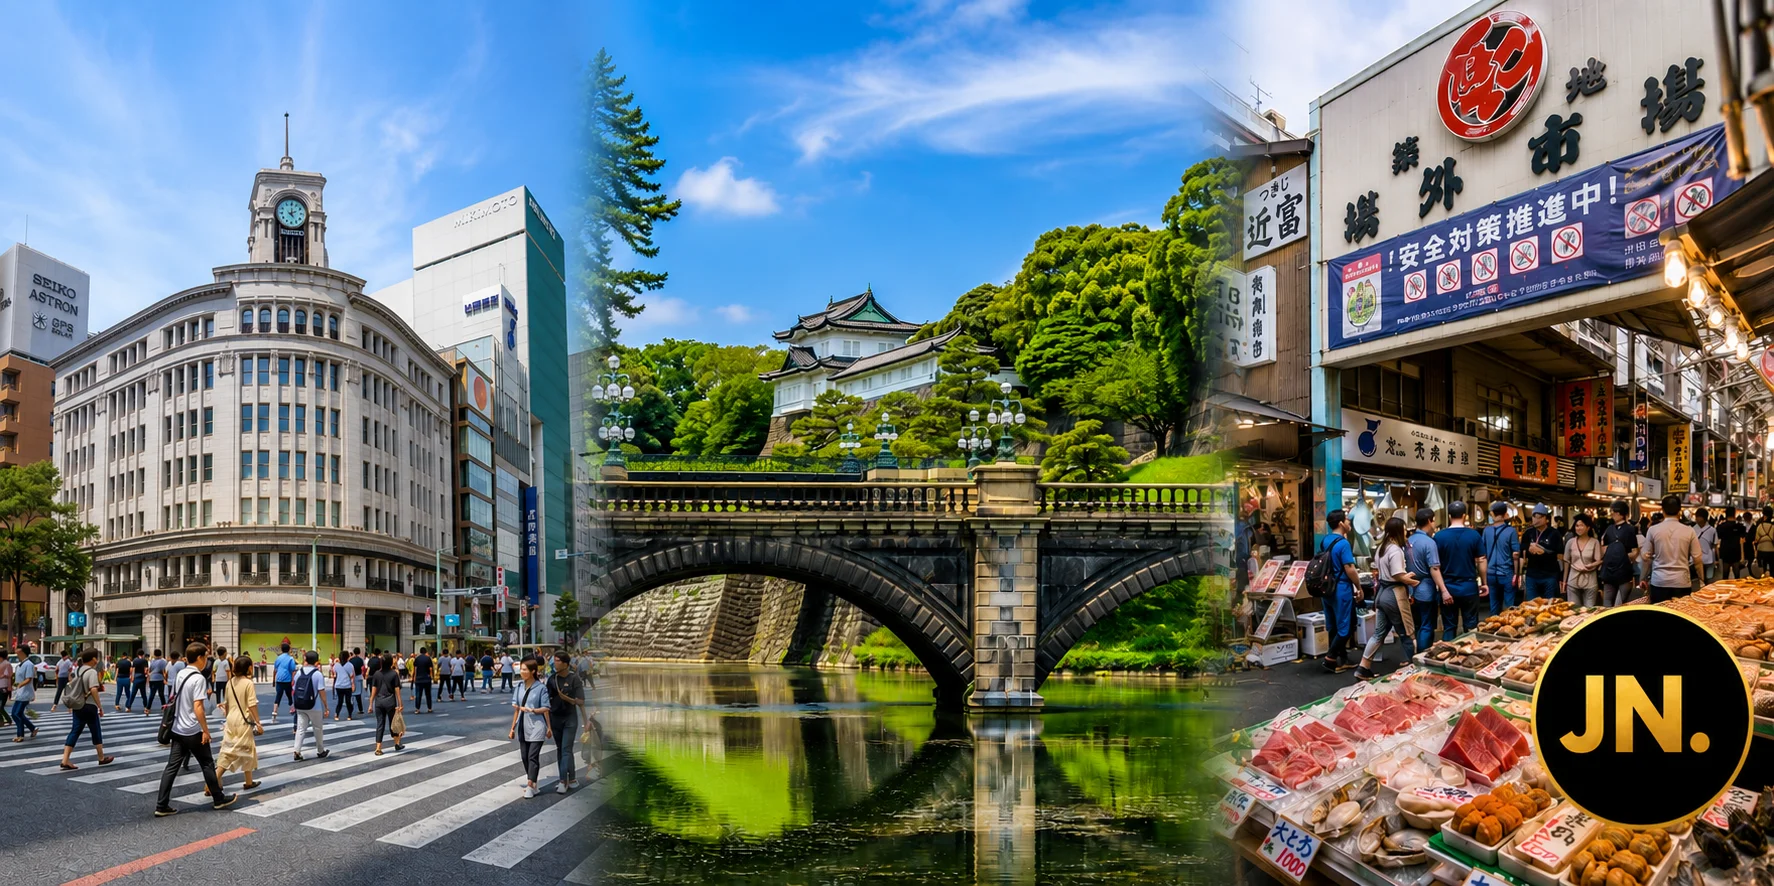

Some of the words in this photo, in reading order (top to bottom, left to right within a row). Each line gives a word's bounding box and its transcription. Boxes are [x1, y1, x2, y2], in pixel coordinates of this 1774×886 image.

[1259, 176, 1289, 201] つきじ
[1247, 193, 1303, 250] 近富
[33, 273, 76, 299] SEIKO
[29, 289, 78, 316] ASTRON
[52, 318, 73, 333] GPS
[1275, 847, 1306, 876] 1000
